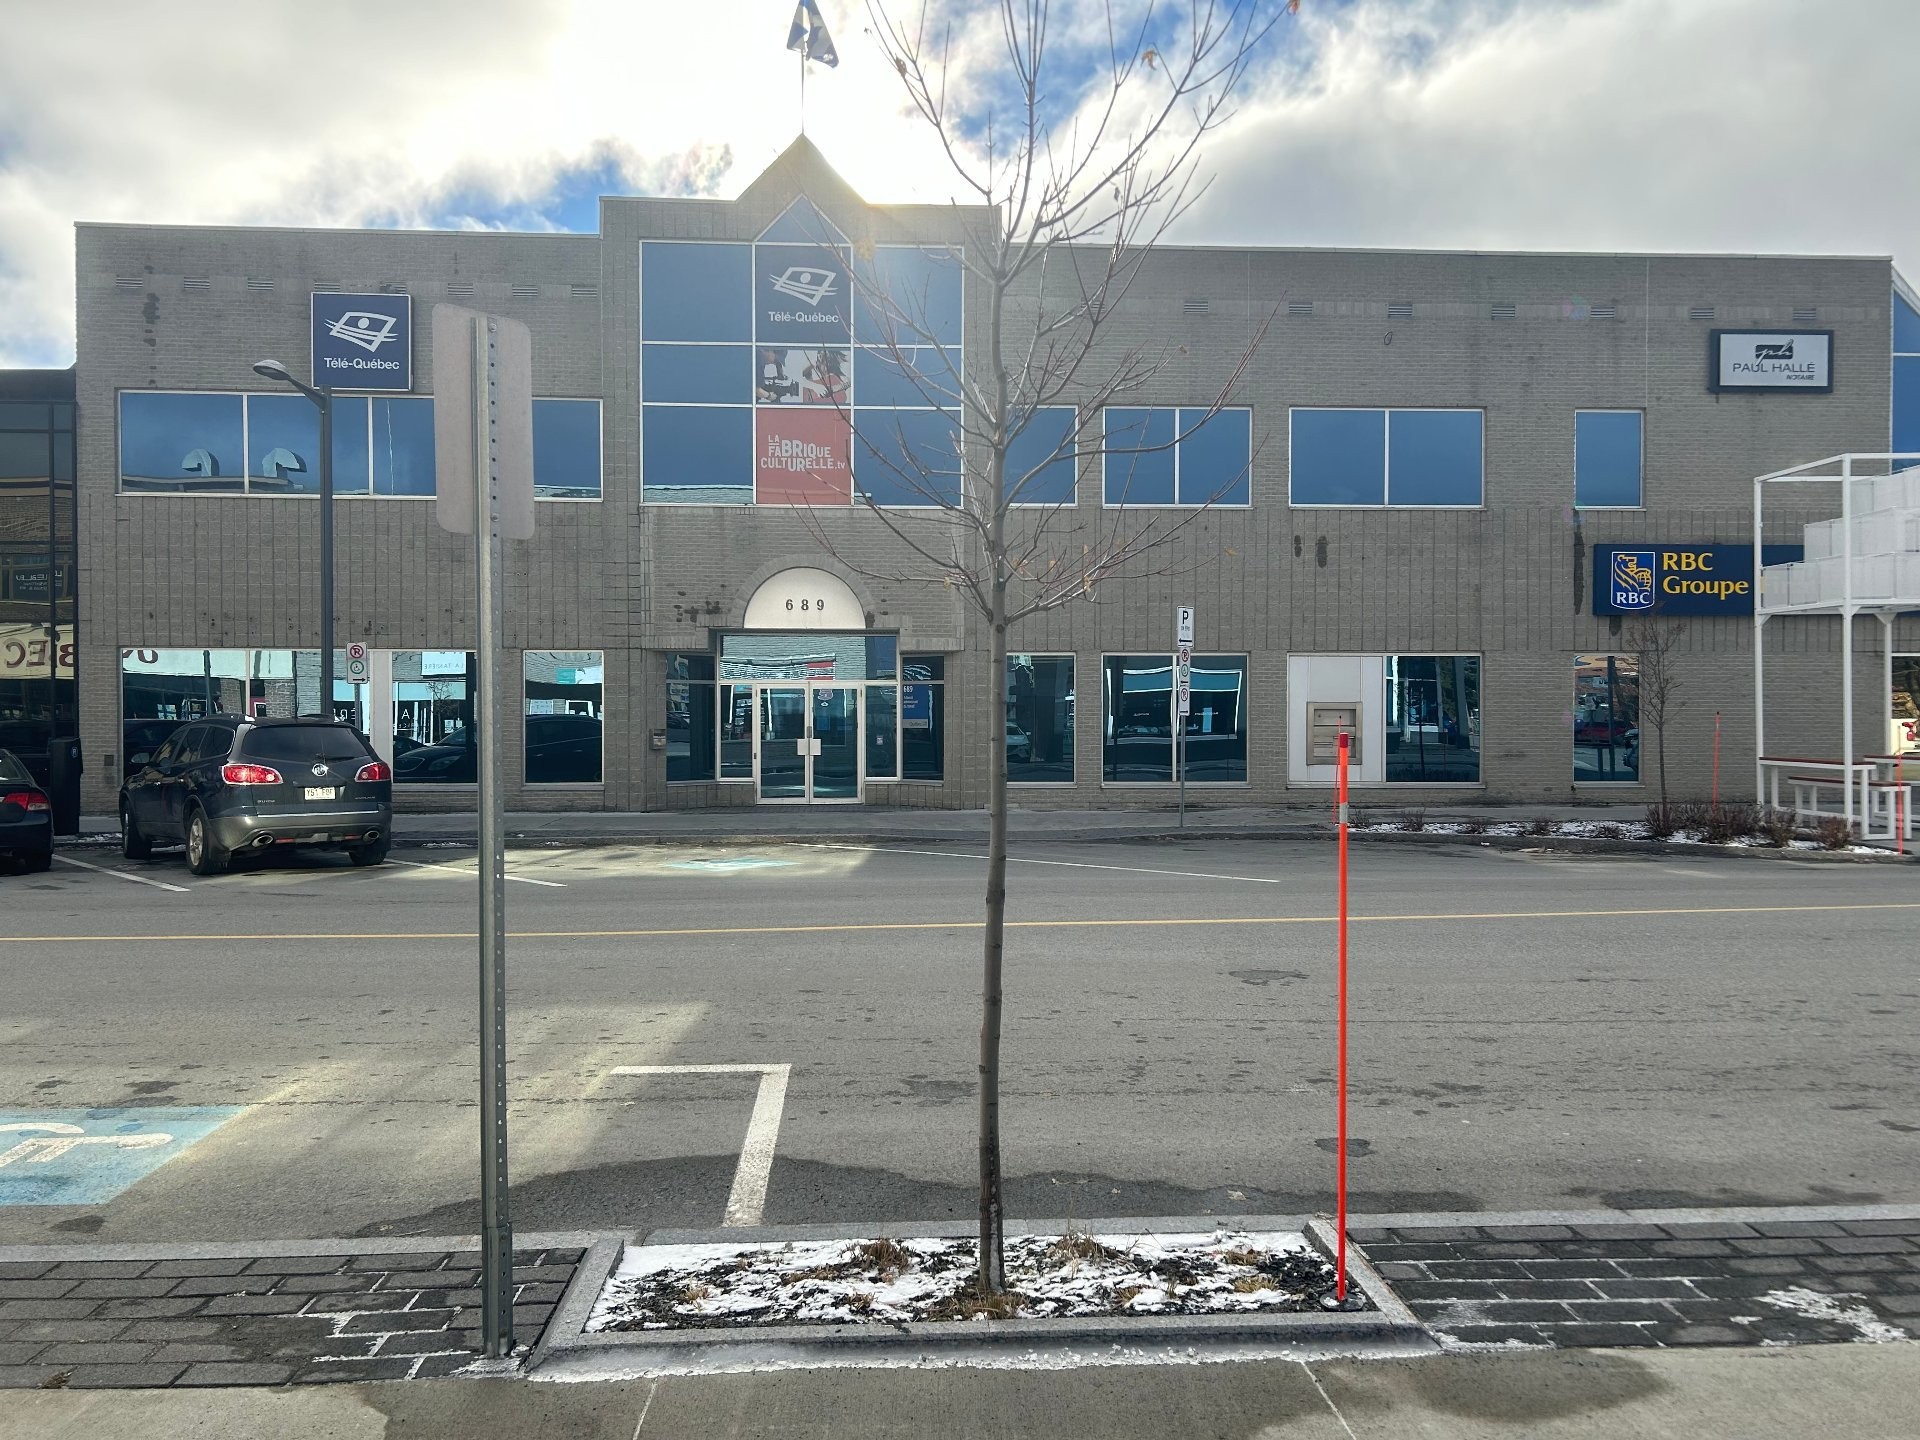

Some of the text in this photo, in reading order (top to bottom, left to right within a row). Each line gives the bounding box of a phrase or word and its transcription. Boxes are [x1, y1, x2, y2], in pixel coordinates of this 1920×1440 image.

[768, 311, 839, 323] Télé-Québec
[323, 357, 400, 370] Télé-Québec
[1732, 361, 1815, 373] PAUL HALLÉ
[768, 434, 780, 443] LA
[768, 440, 831, 459] FABRIQUE
[1662, 552, 1713, 571] RBC
[1662, 576, 1749, 600] Groupe
[785, 598, 825, 611] 689
[1616, 592, 1650, 604] RBC
